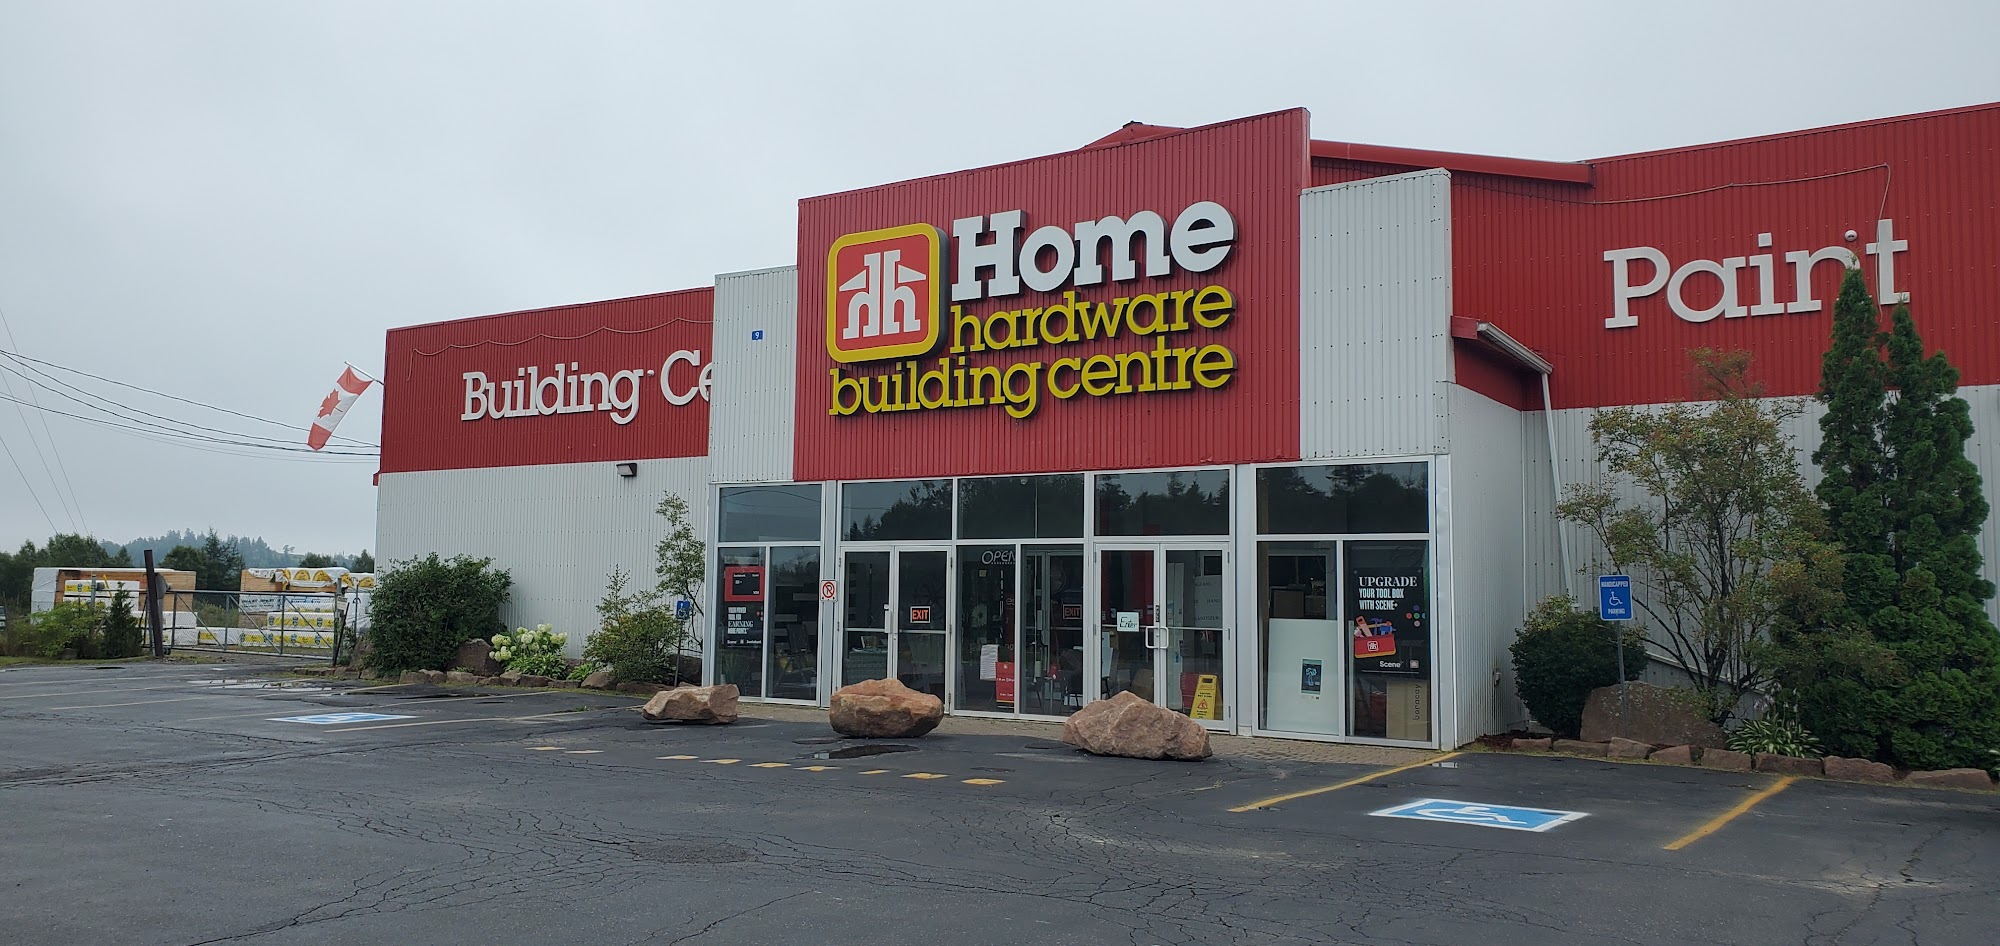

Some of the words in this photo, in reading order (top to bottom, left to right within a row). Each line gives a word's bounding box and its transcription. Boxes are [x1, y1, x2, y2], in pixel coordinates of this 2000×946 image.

[951, 200, 1236, 302] Home
[1603, 218, 1911, 329] Paint
[950, 284, 1235, 354] hardware
[754, 331, 760, 340] 9
[829, 353, 1042, 419] building
[1047, 335, 1234, 399] centre
[461, 361, 644, 425] Building
[981, 550, 1015, 565] OPEN
[1358, 576, 1418, 587] UPGRADE
[1600, 580, 1629, 588] HANDICAPPED
[1358, 588, 1375, 599] YOUR
[1375, 588, 1391, 599] TOOL
[1391, 588, 1405, 599] BOX
[1358, 599, 1374, 611] WITH
[911, 609, 929, 620] EXIT
[1064, 607, 1081, 617] EXIT
[727, 620, 754, 628] EARNING
[1119, 616, 1138, 628] Enter
